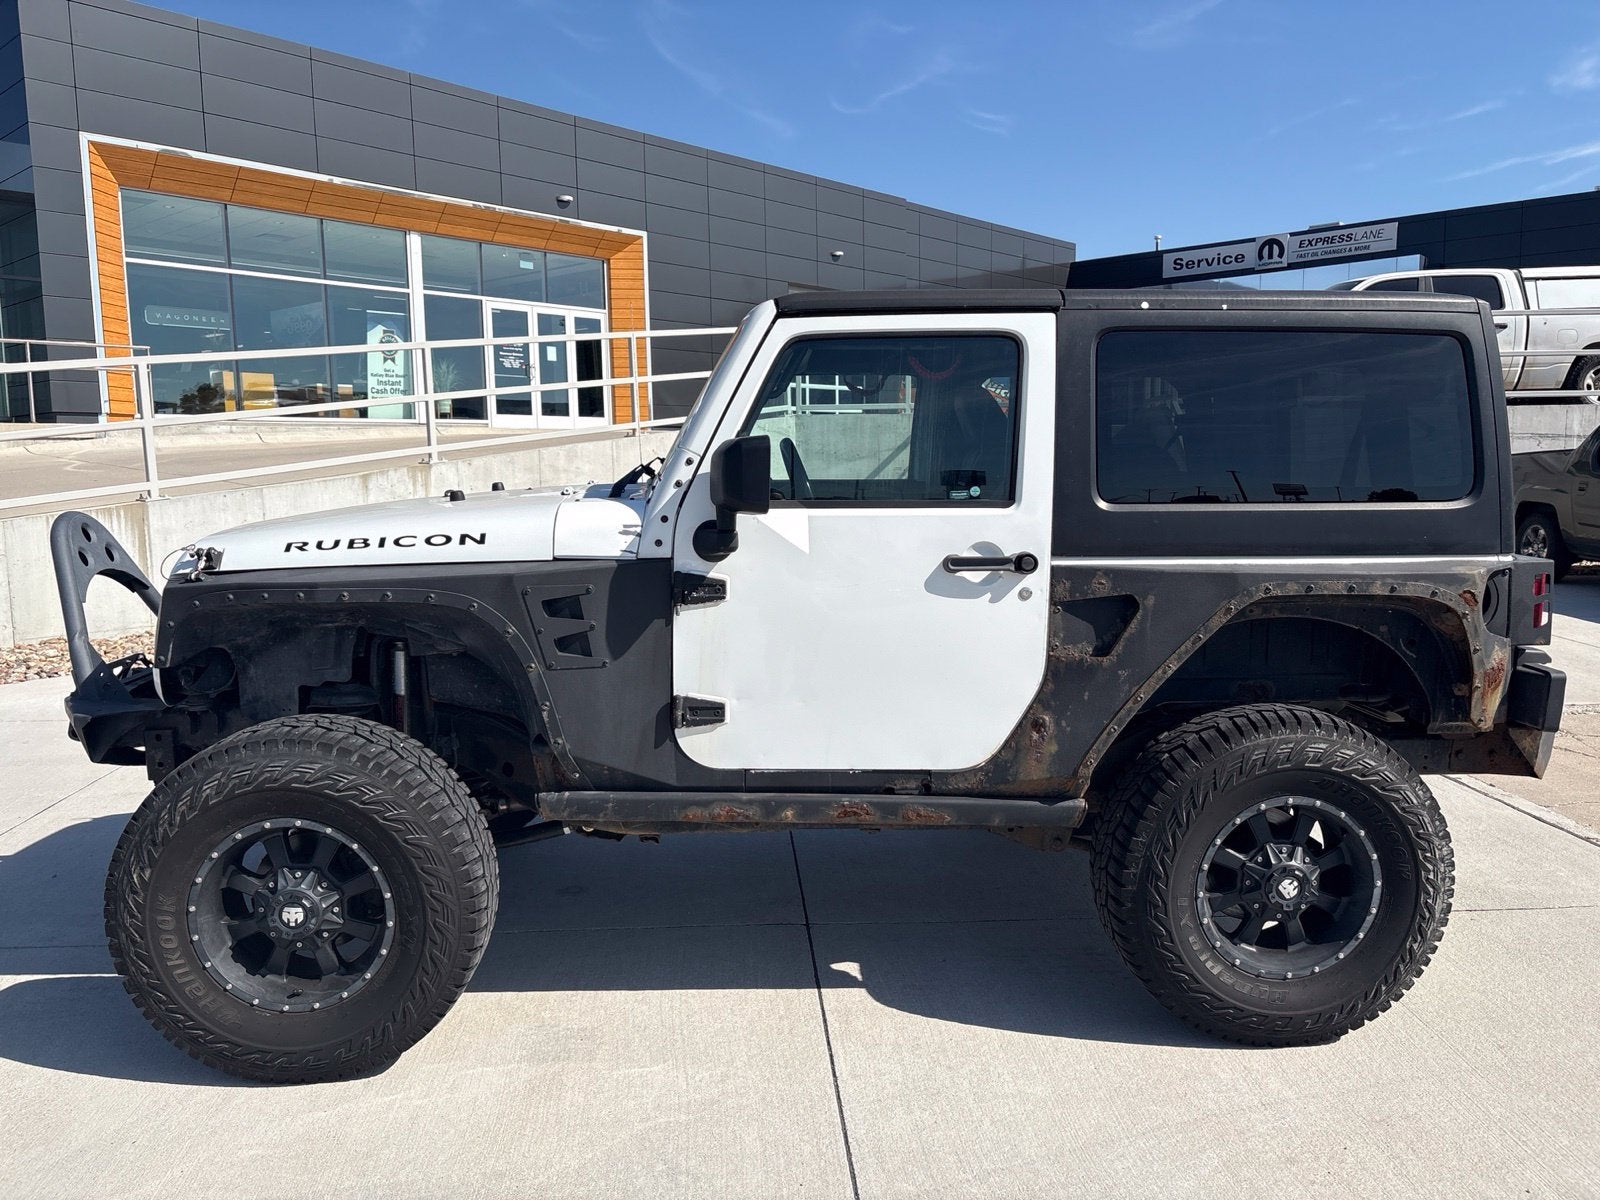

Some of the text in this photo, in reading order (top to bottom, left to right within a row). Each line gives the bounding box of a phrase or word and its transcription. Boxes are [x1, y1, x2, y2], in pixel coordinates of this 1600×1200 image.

[1298, 228, 1385, 249] EXPRESSLANE
[1296, 252, 1311, 260] FAST
[1320, 247, 1347, 256] CHANGES
[1354, 244, 1372, 252] MORE
[1172, 252, 1246, 271] Service
[371, 386, 408, 395] Cash Offer
[377, 378, 402, 387] Instant
[284, 532, 487, 553] RUBICON
